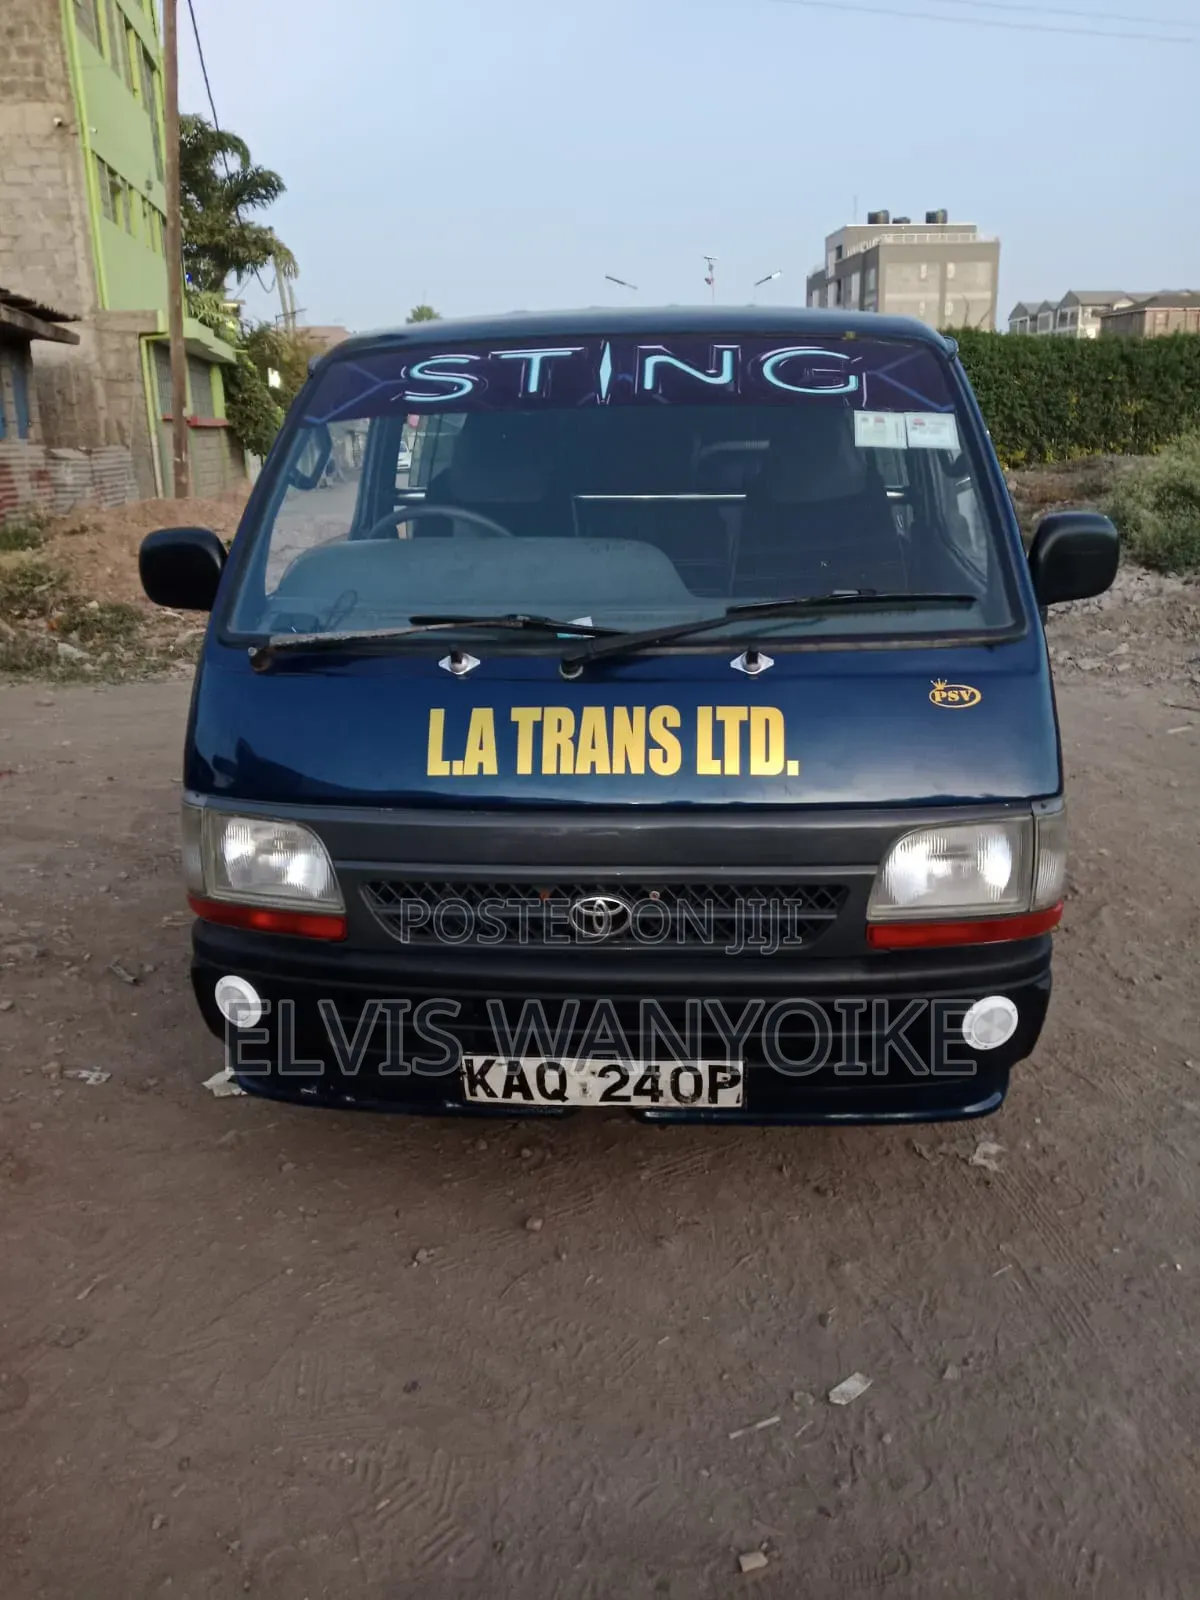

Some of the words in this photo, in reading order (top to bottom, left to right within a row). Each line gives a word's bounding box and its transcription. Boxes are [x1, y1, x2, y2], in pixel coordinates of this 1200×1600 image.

[401, 340, 866, 402] STING
[933, 690, 972, 702] PSV
[426, 707, 499, 776] L.A
[510, 704, 682, 776] TRANS
[696, 705, 800, 776] LTD.
[464, 1058, 568, 1102] KAQ
[597, 1063, 742, 1105] 240P
